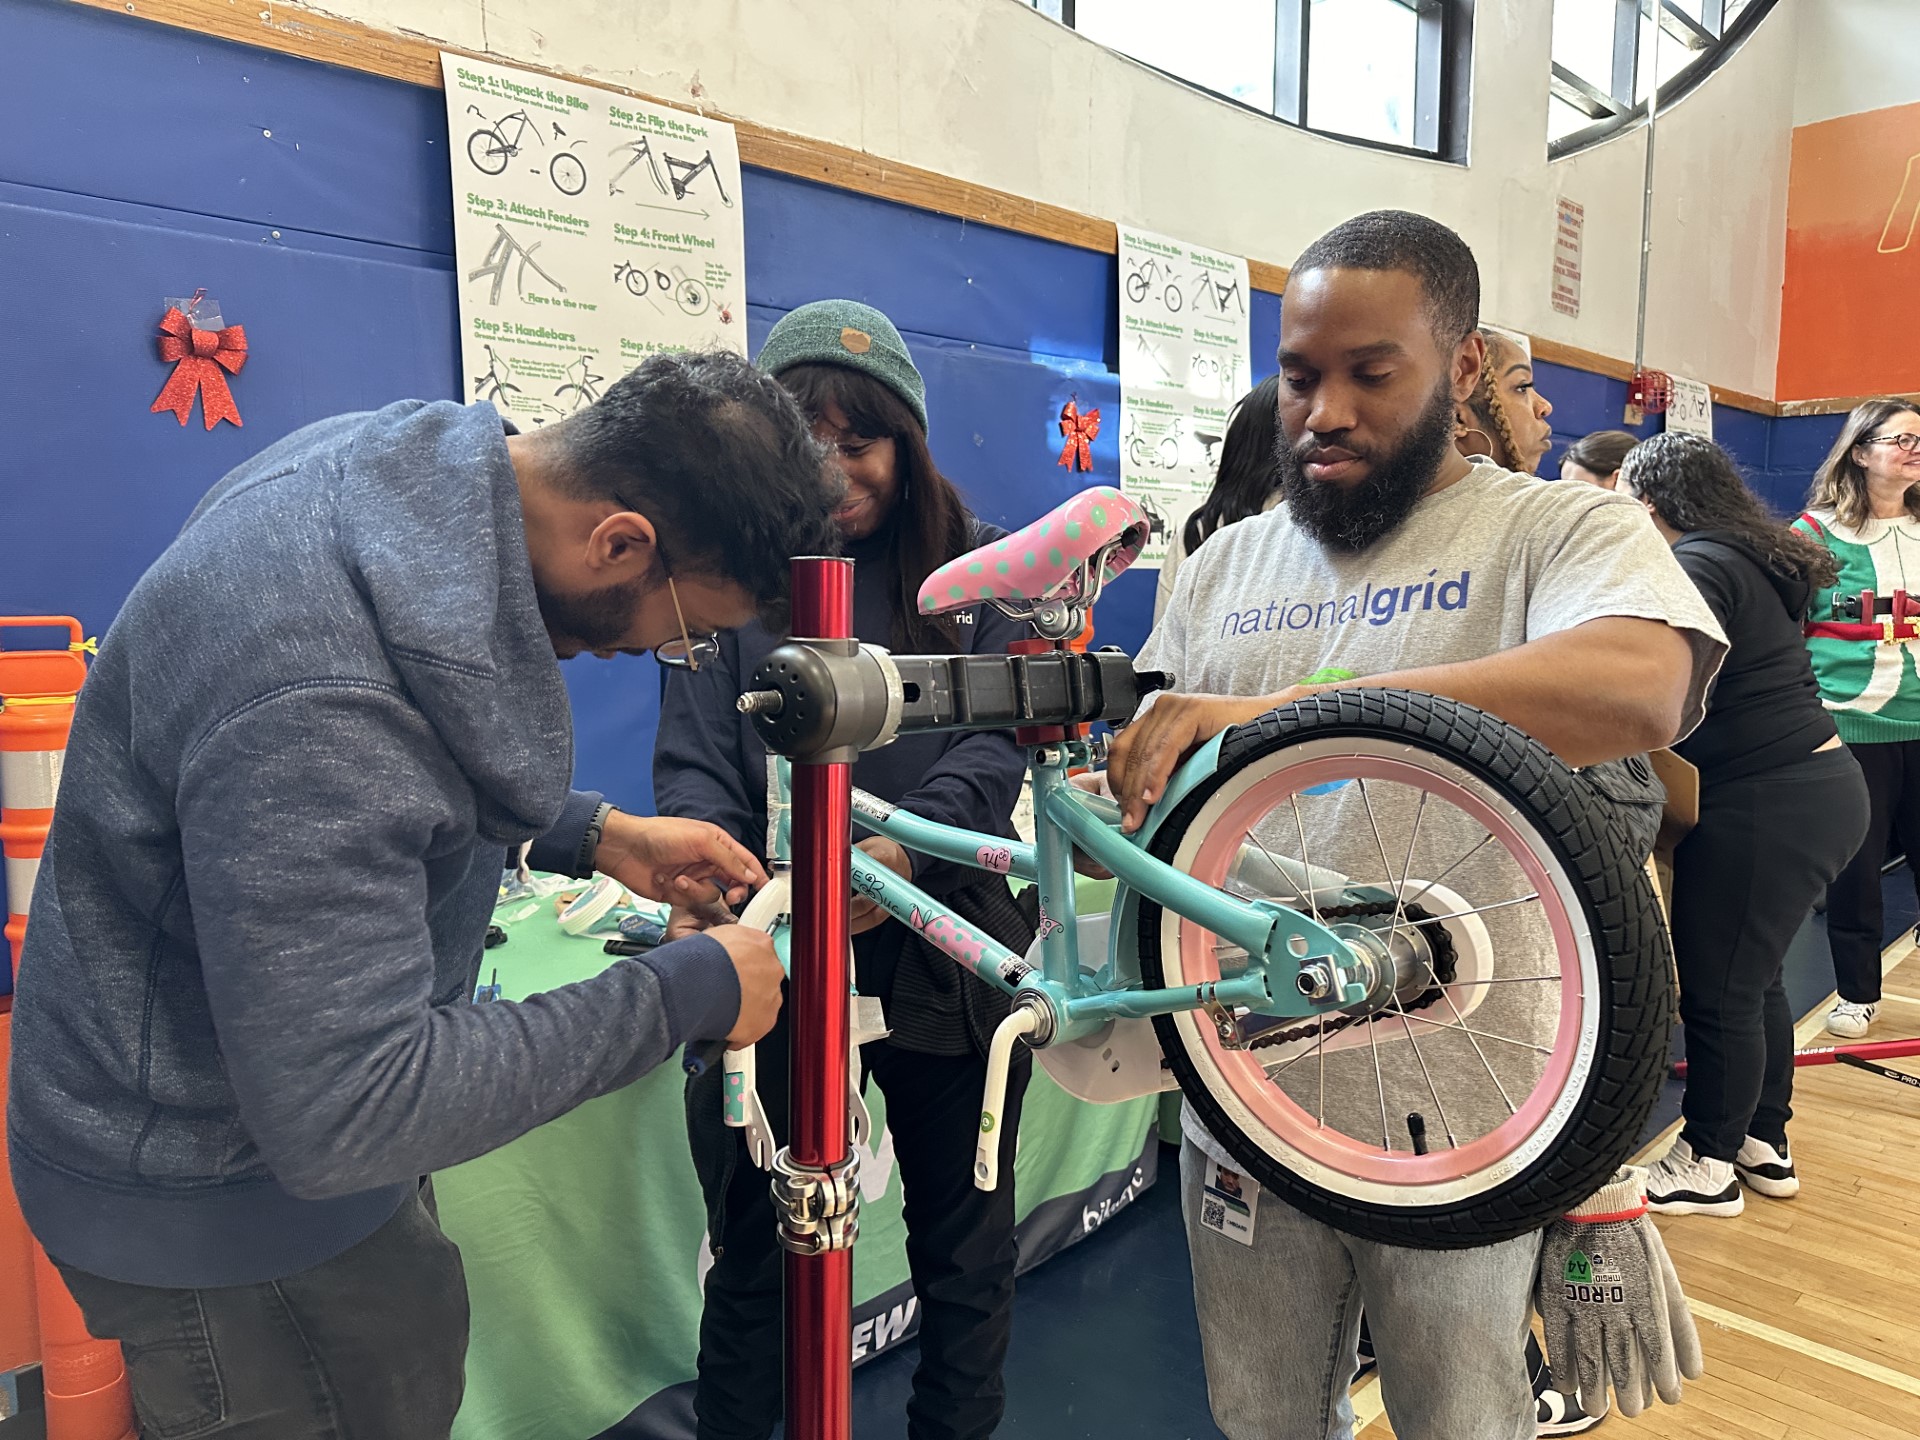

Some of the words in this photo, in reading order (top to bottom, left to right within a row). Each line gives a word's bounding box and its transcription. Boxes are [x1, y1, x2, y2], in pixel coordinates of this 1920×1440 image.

[456, 67, 485, 86] Step
[488, 76, 500, 87] 1:
[501, 79, 545, 99] Unpack
[545, 91, 564, 104] the
[565, 95, 589, 111] Bike
[609, 105, 634, 124] Step
[636, 112, 647, 124] 2:
[648, 114, 666, 129] Flip
[667, 120, 684, 132] the
[685, 123, 709, 138] Fork
[466, 192, 494, 210] Step
[496, 198, 508, 211] 3:
[509, 202, 546, 219] Attach
[547, 209, 590, 228] Fenders
[613, 222, 638, 240] Step
[640, 227, 650, 239] 4:
[652, 229, 680, 243] Front
[681, 233, 715, 249] Wheel
[528, 292, 550, 304] Flare
[552, 297, 561, 306] to
[563, 299, 577, 308] the
[578, 302, 598, 311] rear
[473, 317, 500, 335] Step
[502, 321, 513, 333] 5:
[515, 323, 576, 343] Handlebars
[620, 337, 643, 353] Step
[645, 341, 655, 352] 6:
[657, 342, 690, 353] Saddl
[1220, 568, 1471, 640] nationalgrid
[1901, 1074, 1920, 1089] PRO-
[1568, 1260, 1588, 1274] A4
